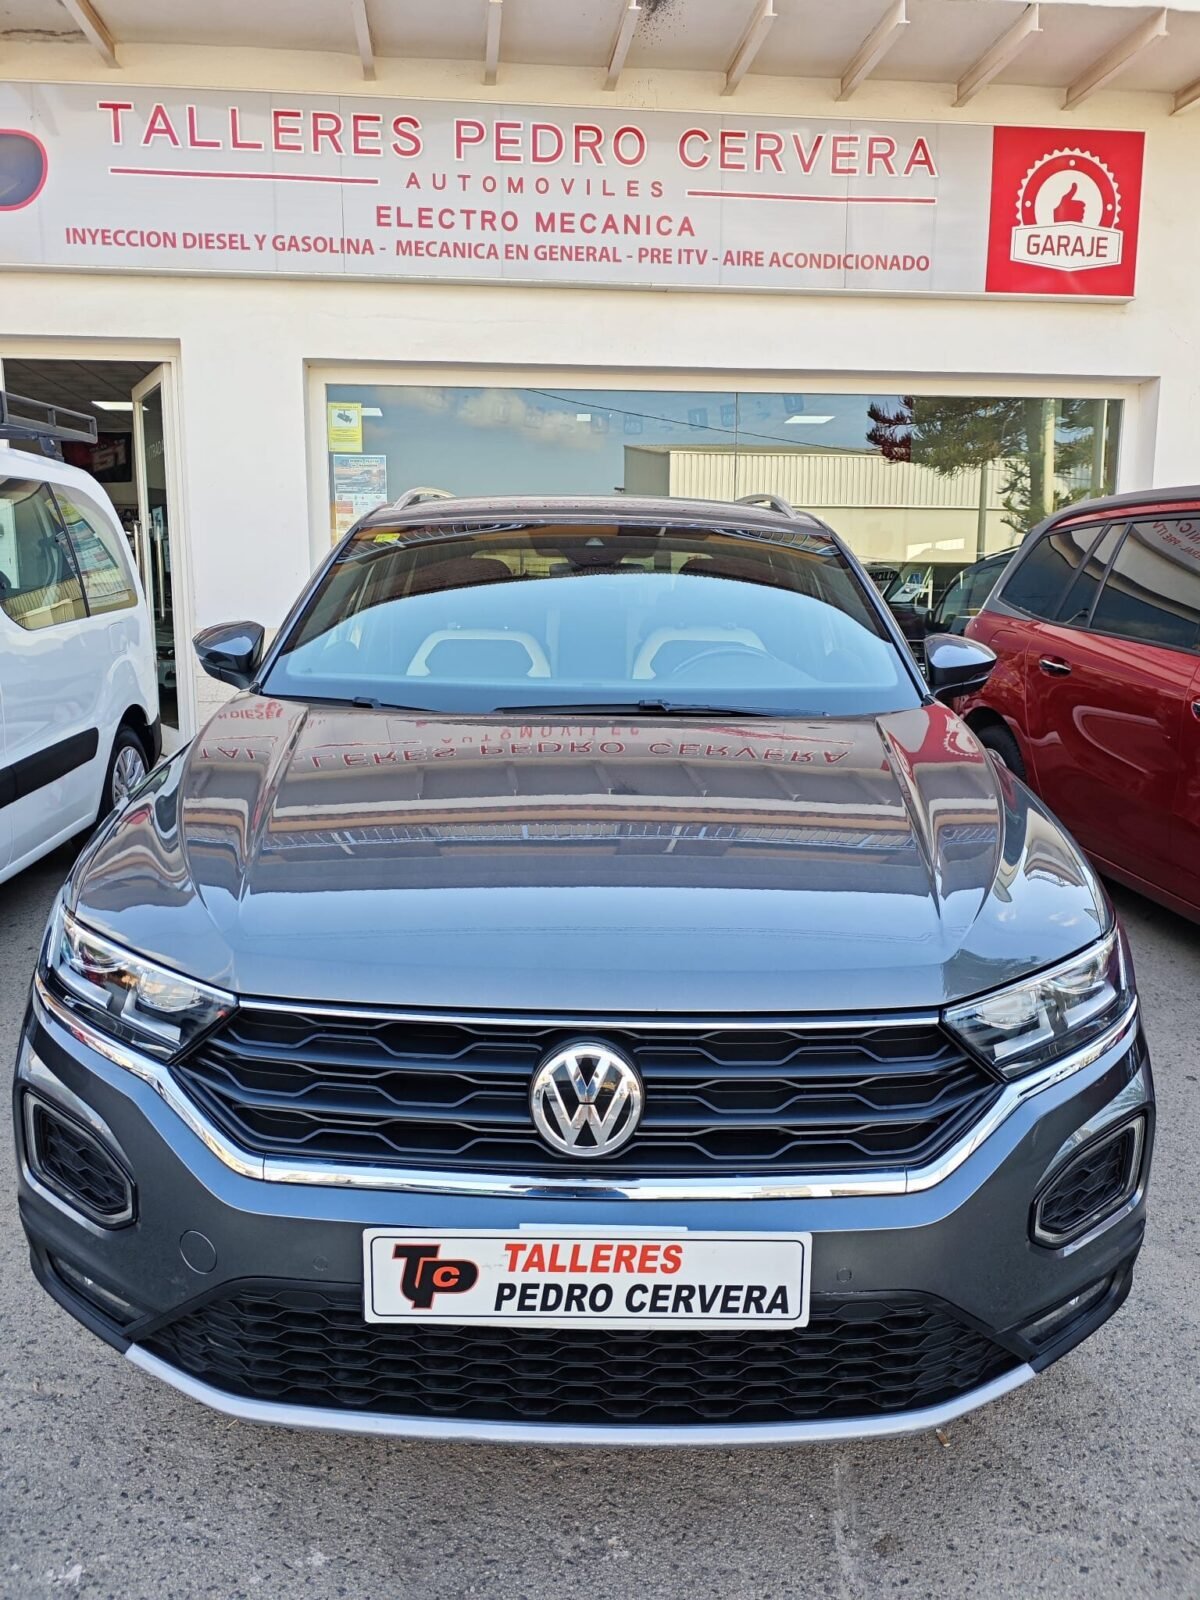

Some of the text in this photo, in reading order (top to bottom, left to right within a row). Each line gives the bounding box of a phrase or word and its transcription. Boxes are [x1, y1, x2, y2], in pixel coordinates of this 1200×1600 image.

[98, 101, 936, 177] TALLERES PEDRO CERVERA
[406, 172, 663, 197] AUTOMOVILES
[376, 206, 695, 237] ELECTRO MECANICA
[65, 228, 178, 249] INYECCION
[182, 233, 250, 251] DIESEL
[255, 235, 267, 249] Y
[272, 236, 375, 256] GASOLINA
[396, 240, 500, 260] MECANICA
[504, 244, 530, 261] EN
[534, 245, 621, 263] GENERAL
[638, 248, 672, 264] PRE
[678, 249, 708, 266] ITV
[723, 251, 764, 267] AIRE
[769, 252, 931, 272] ACONDICIONADO
[1026, 234, 1109, 259] GARAJE
[504, 1243, 683, 1274] TALLERES
[494, 1282, 790, 1314] PEDRO CERVERA
